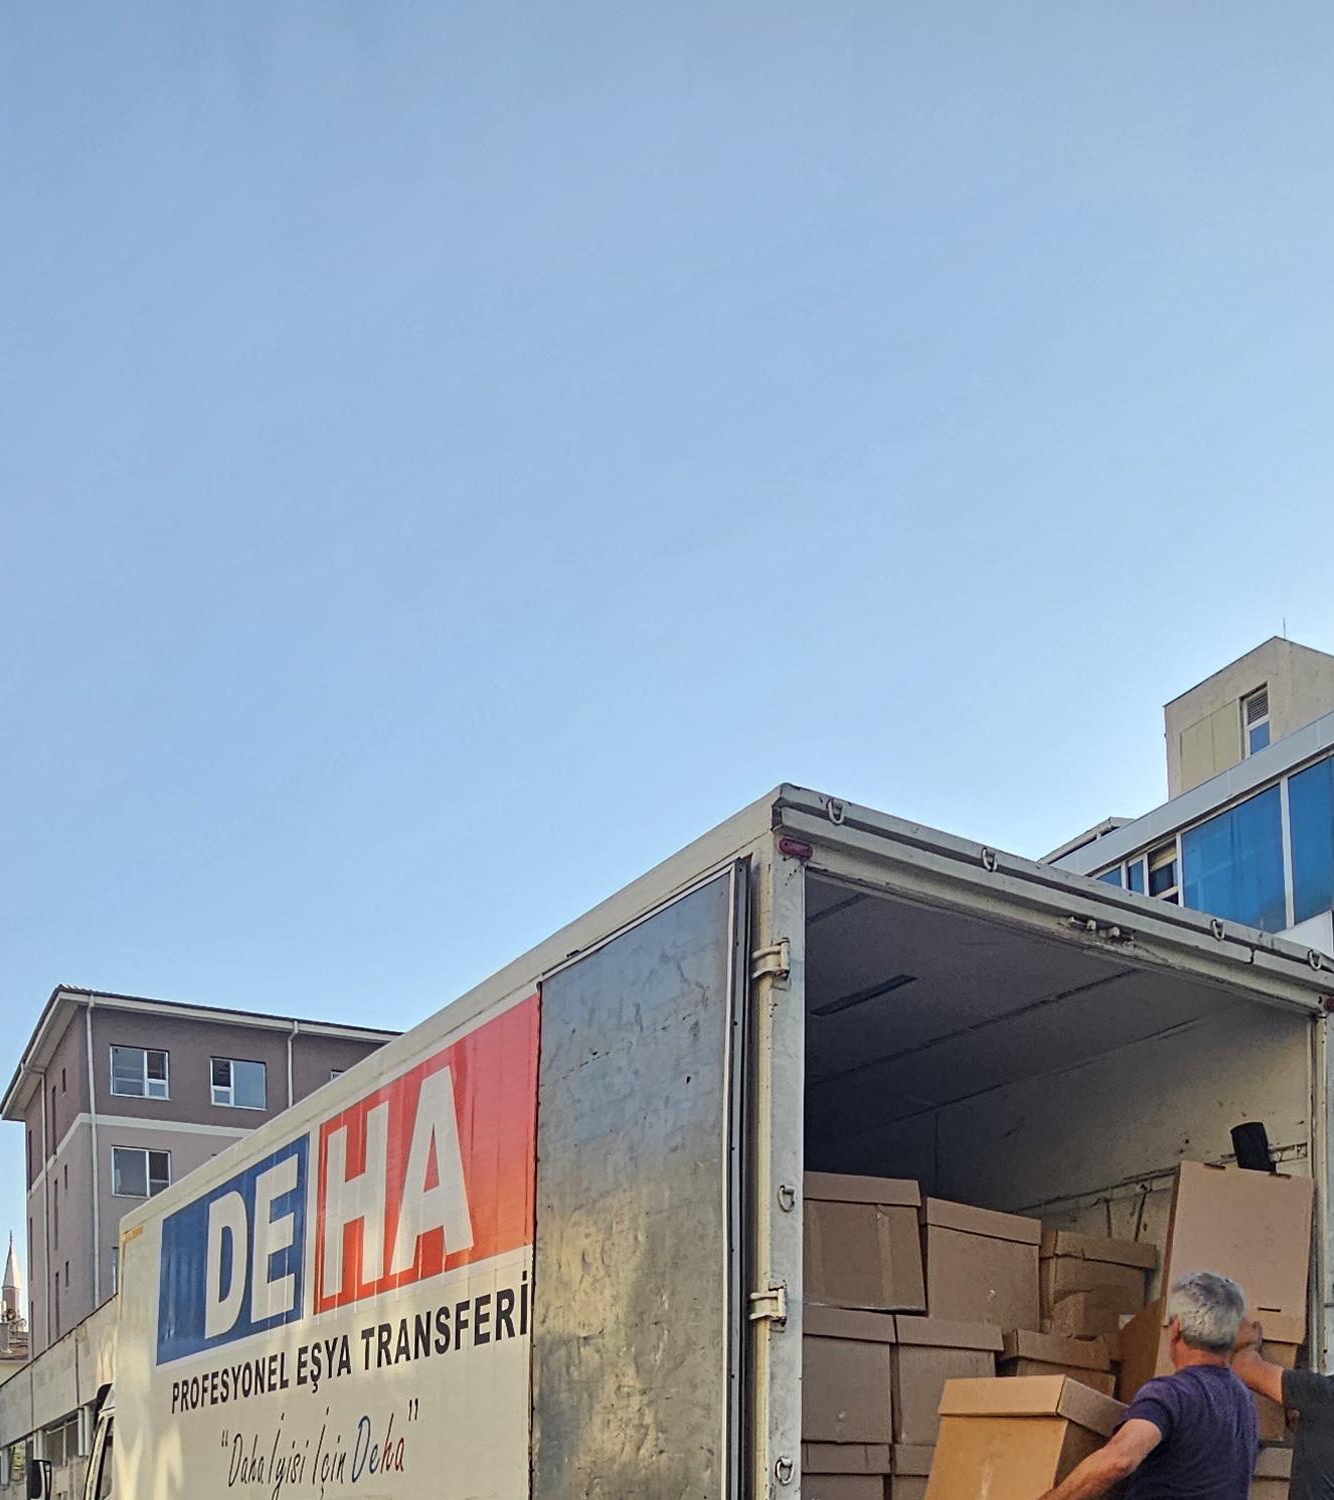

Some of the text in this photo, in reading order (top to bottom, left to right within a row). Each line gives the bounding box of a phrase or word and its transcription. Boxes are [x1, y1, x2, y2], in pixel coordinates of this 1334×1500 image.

[205, 1065, 474, 1340] DEHA
[171, 1270, 528, 1414] PROFESYONEL EŞYA TRANSFERİ
[312, 1406, 347, 1500] İçin
